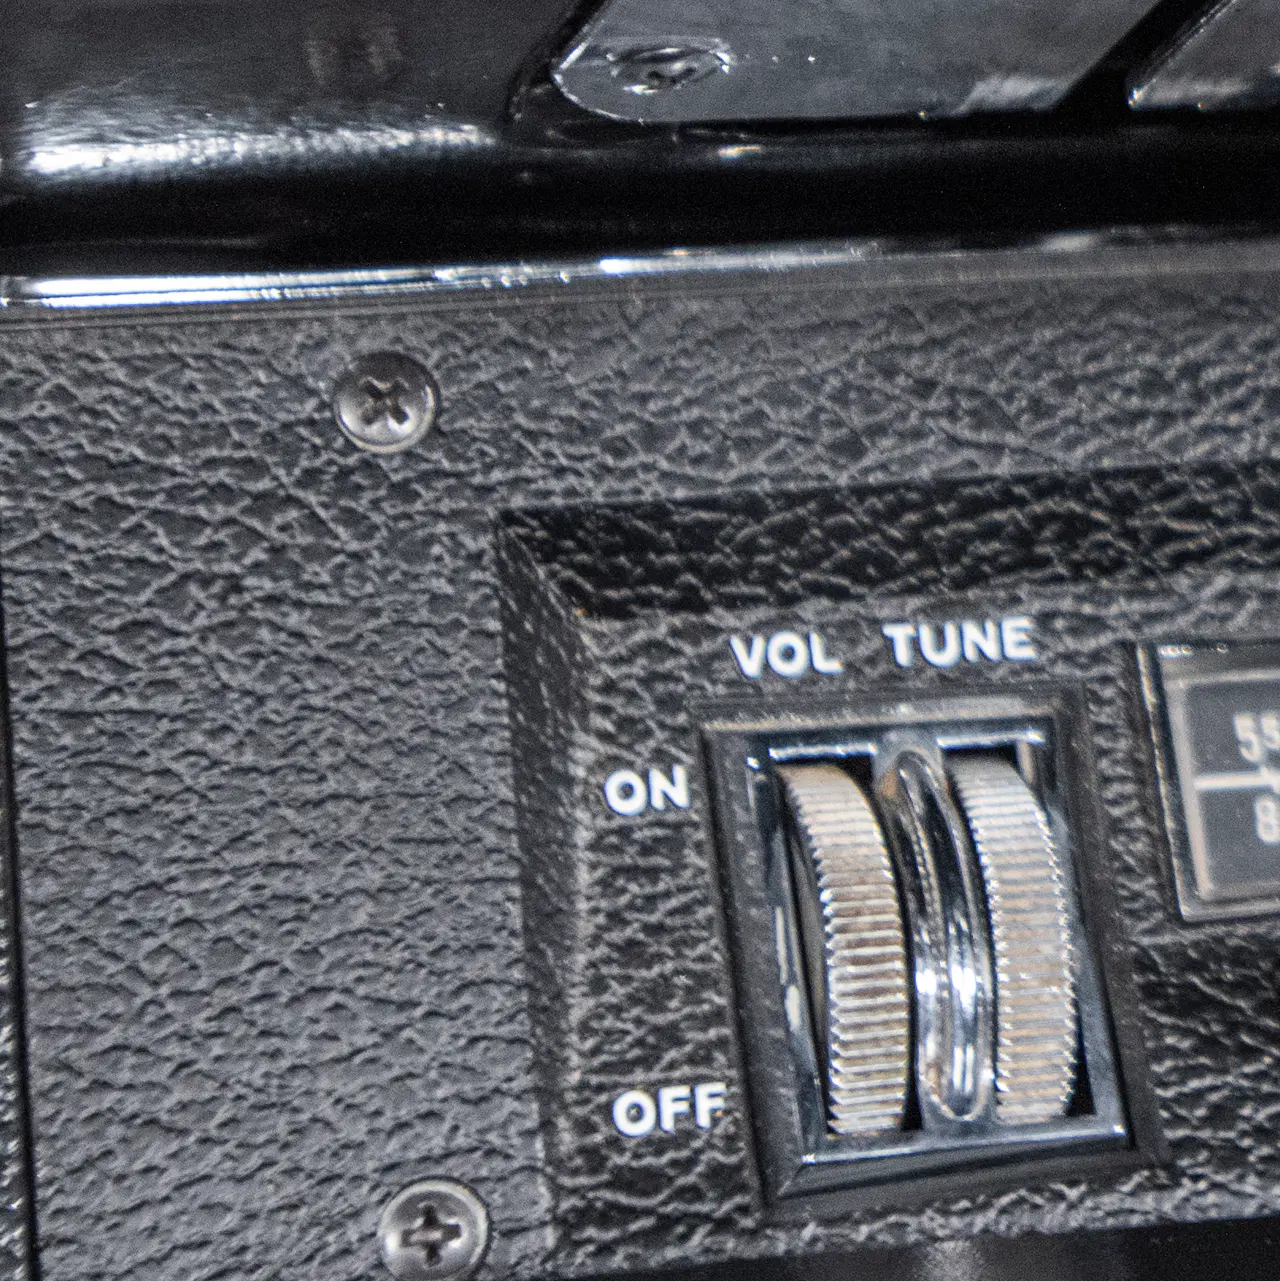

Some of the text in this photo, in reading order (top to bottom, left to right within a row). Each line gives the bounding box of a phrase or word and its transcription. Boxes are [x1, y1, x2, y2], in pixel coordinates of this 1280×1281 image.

[730, 615, 1039, 678] VOL TUNE
[603, 763, 690, 816] ON
[612, 1081, 728, 1137] OFF
